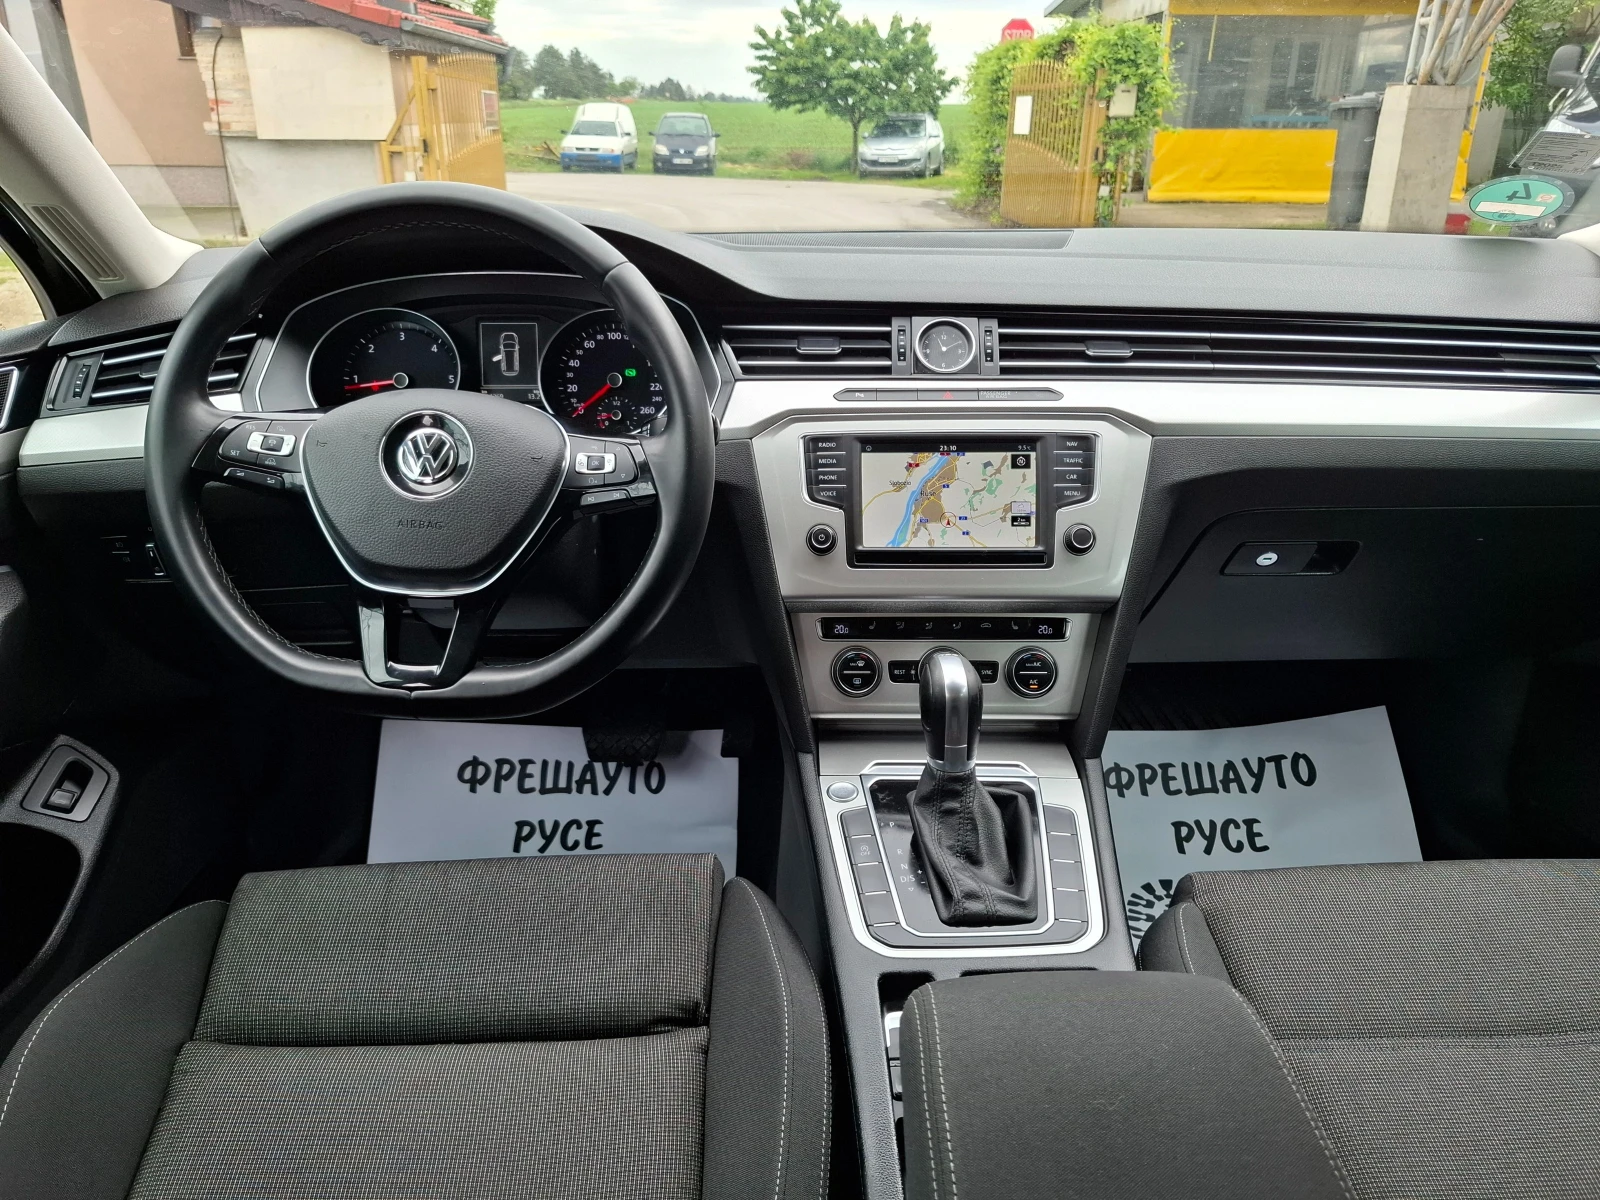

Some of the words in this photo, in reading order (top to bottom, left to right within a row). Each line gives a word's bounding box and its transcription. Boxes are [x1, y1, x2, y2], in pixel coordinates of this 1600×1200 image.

[1004, 28, 1032, 40] STOP
[400, 332, 405, 340] 3
[398, 519, 442, 530] AIRBAG
[456, 756, 666, 796] ФРЕШАУТО
[1104, 752, 1317, 798] ФРЕШАУТО
[512, 818, 604, 854] РУСЕ
[1170, 818, 1270, 856] РУСЕ
